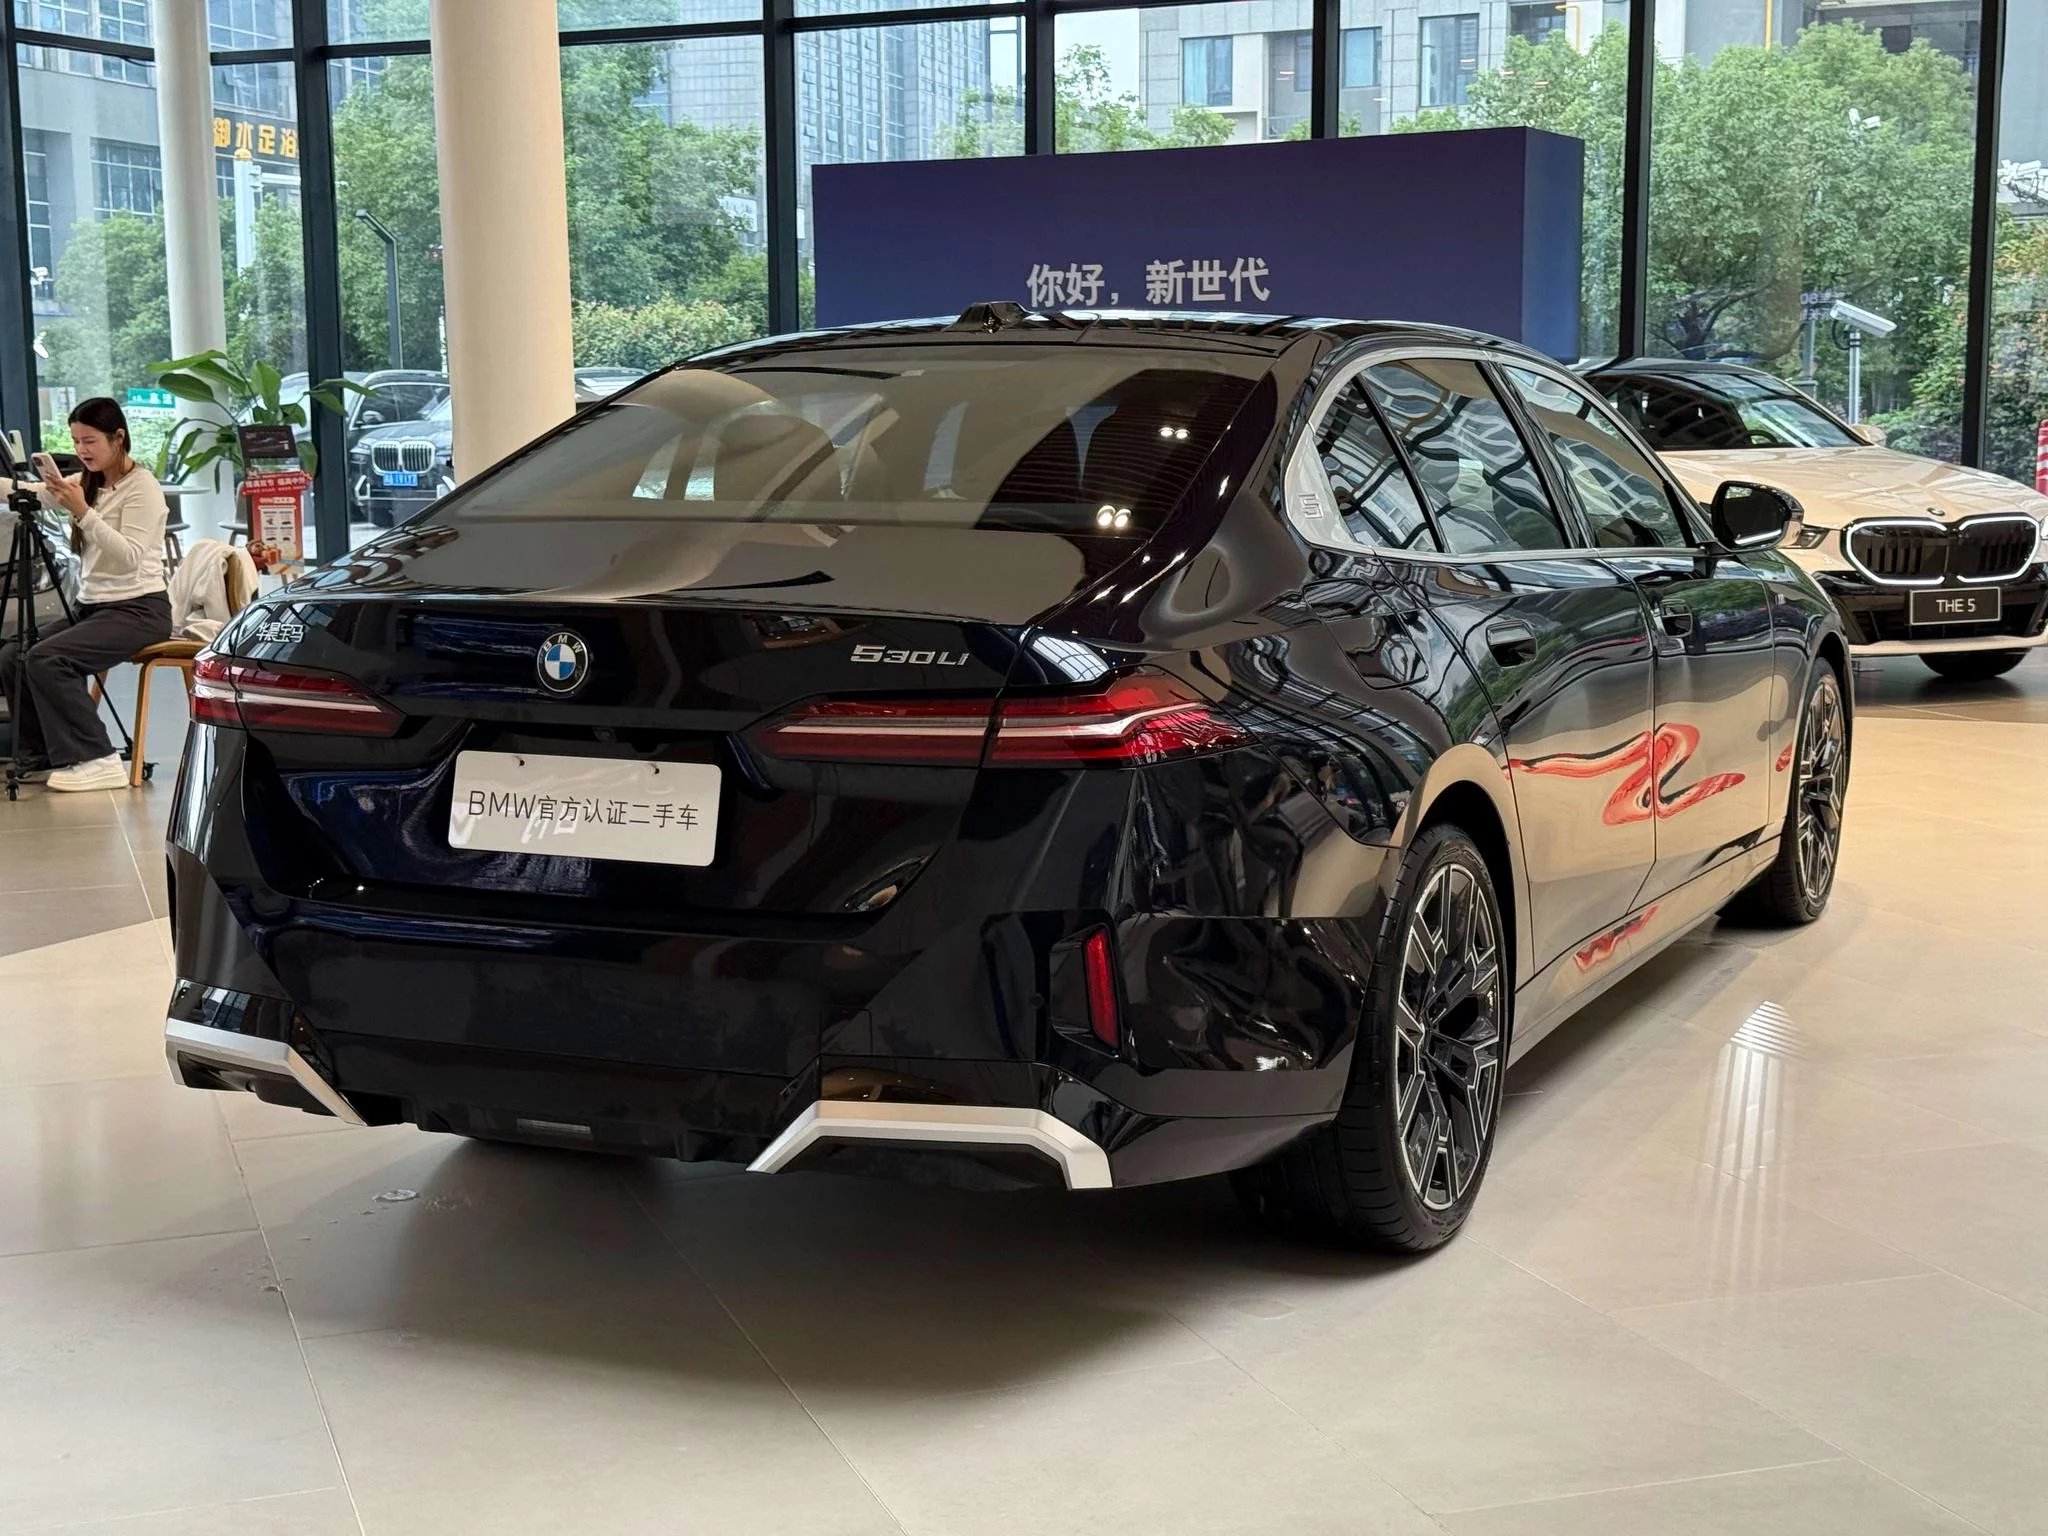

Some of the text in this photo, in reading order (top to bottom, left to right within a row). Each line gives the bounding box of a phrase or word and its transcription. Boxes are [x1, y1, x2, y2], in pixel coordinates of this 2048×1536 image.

[1936, 598, 1976, 613] THE 5
[256, 622, 304, 643] 华晨宝马
[543, 634, 583, 654] BMW
[850, 644, 969, 665] 530Li
[468, 791, 699, 830] BMW官方认证二手车
